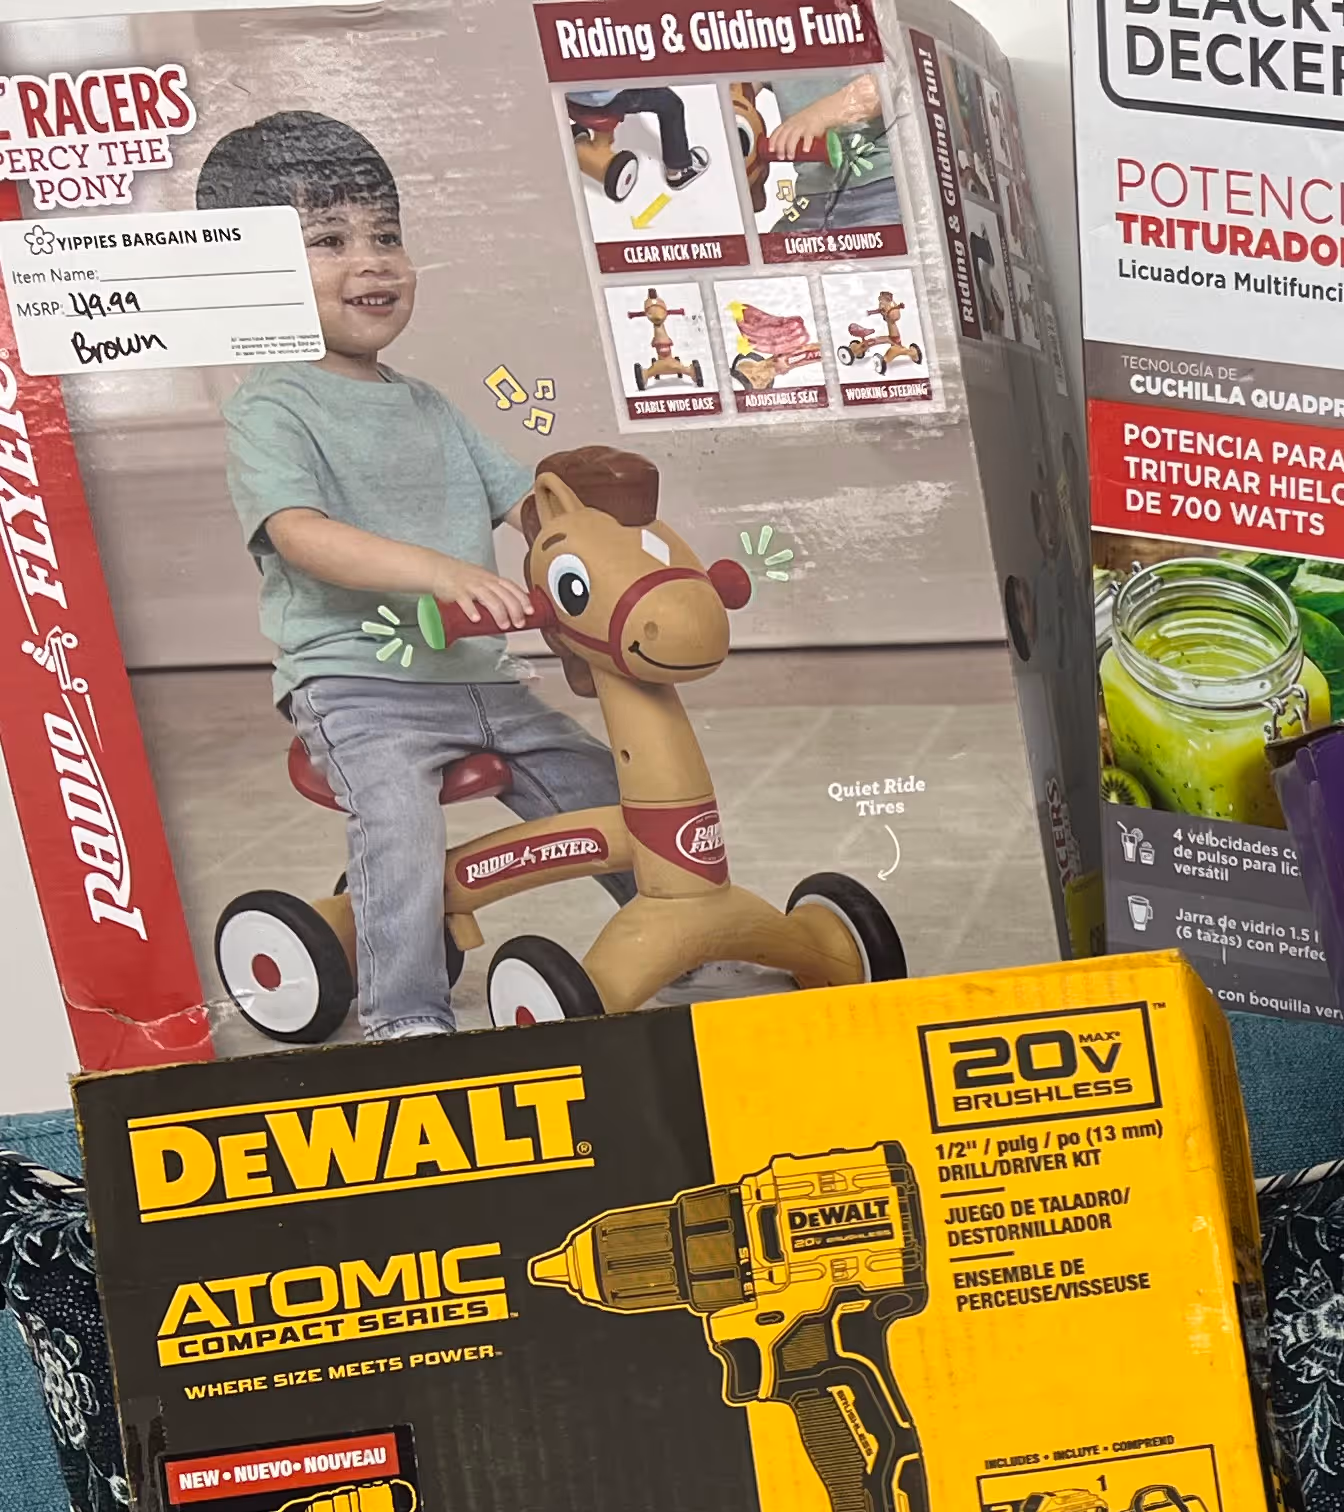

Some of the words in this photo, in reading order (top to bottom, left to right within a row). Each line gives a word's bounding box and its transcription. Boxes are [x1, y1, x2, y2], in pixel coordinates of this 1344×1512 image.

[556, 16, 655, 61] Riding
[661, 14, 686, 54] &
[690, 9, 796, 55] Gliding
[799, 4, 865, 45] Fun!
[22, 69, 191, 139] RACERS
[38, 176, 129, 203] PONY
[57, 235, 117, 252] YIPPIES
[122, 231, 197, 248] BARGAIN
[203, 227, 242, 243] BINS
[624, 247, 660, 263] CLEAR
[662, 245, 691, 261] KICK
[692, 243, 722, 259] PATH
[785, 237, 825, 254] LIGHTS
[828, 236, 837, 250] &
[838, 232, 883, 250] SOUNDS
[12, 268, 43, 285] Item
[50, 266, 98, 283] Name:
[1118, 259, 1226, 290] Licuadora
[17, 301, 64, 317] MSRP:
[69, 291, 141, 316] 49.99
[71, 332, 167, 365] Brown
[1130, 374, 1245, 406] CUCHILLA
[1124, 423, 1263, 463] POTENCIA
[1124, 456, 1260, 495] TRITURAR
[1126, 489, 1161, 514] DE
[1170, 494, 1221, 522] 700
[1230, 503, 1325, 536] WATTS
[828, 781, 880, 800] Quiet
[884, 777, 926, 795] Ride
[857, 800, 905, 816] Tires
[44, 712, 148, 942] RADIO
[1174, 862, 1229, 881] versátil
[953, 1078, 1133, 1112] BRUSHLESS
[129, 1077, 586, 1211] DEWALT
[938, 1152, 1068, 1183] DRILL/DRIVER
[1073, 1149, 1101, 1168] KIT
[158, 1243, 505, 1336] ATOMIC
[179, 1320, 344, 1358] COMPACT
[358, 1301, 489, 1332] SERIES
[184, 1375, 268, 1400] WHERE
[274, 1369, 323, 1388] SIZE
[329, 1358, 403, 1380] MEETS
[410, 1345, 495, 1368] POWER
[179, 1470, 219, 1490] NEW
[234, 1460, 292, 1483] NUEVO
[304, 1447, 386, 1475] NOUVEAU
